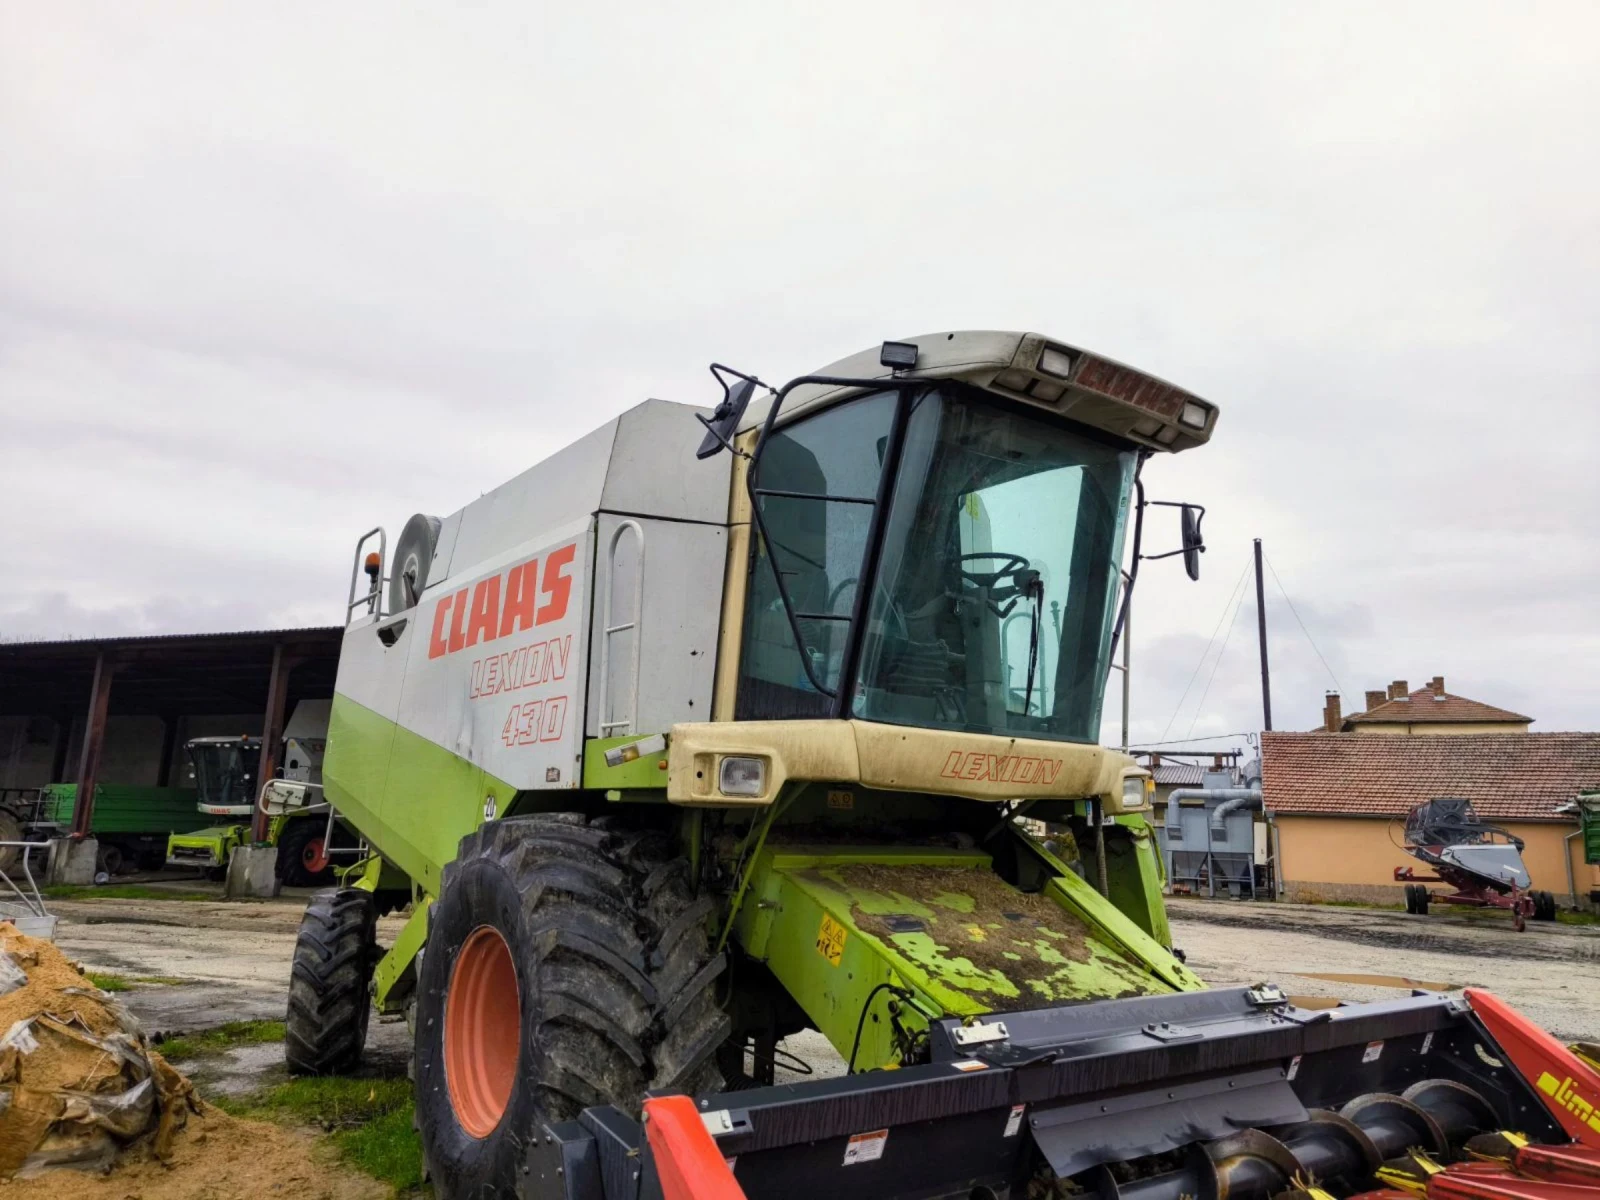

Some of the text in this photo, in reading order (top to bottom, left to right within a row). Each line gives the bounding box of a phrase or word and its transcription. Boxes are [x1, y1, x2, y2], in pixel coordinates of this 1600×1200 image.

[428, 543, 576, 660] CLAAS
[470, 634, 572, 700] LEXION
[501, 696, 568, 747] 430
[940, 750, 1063, 785] LEXION
